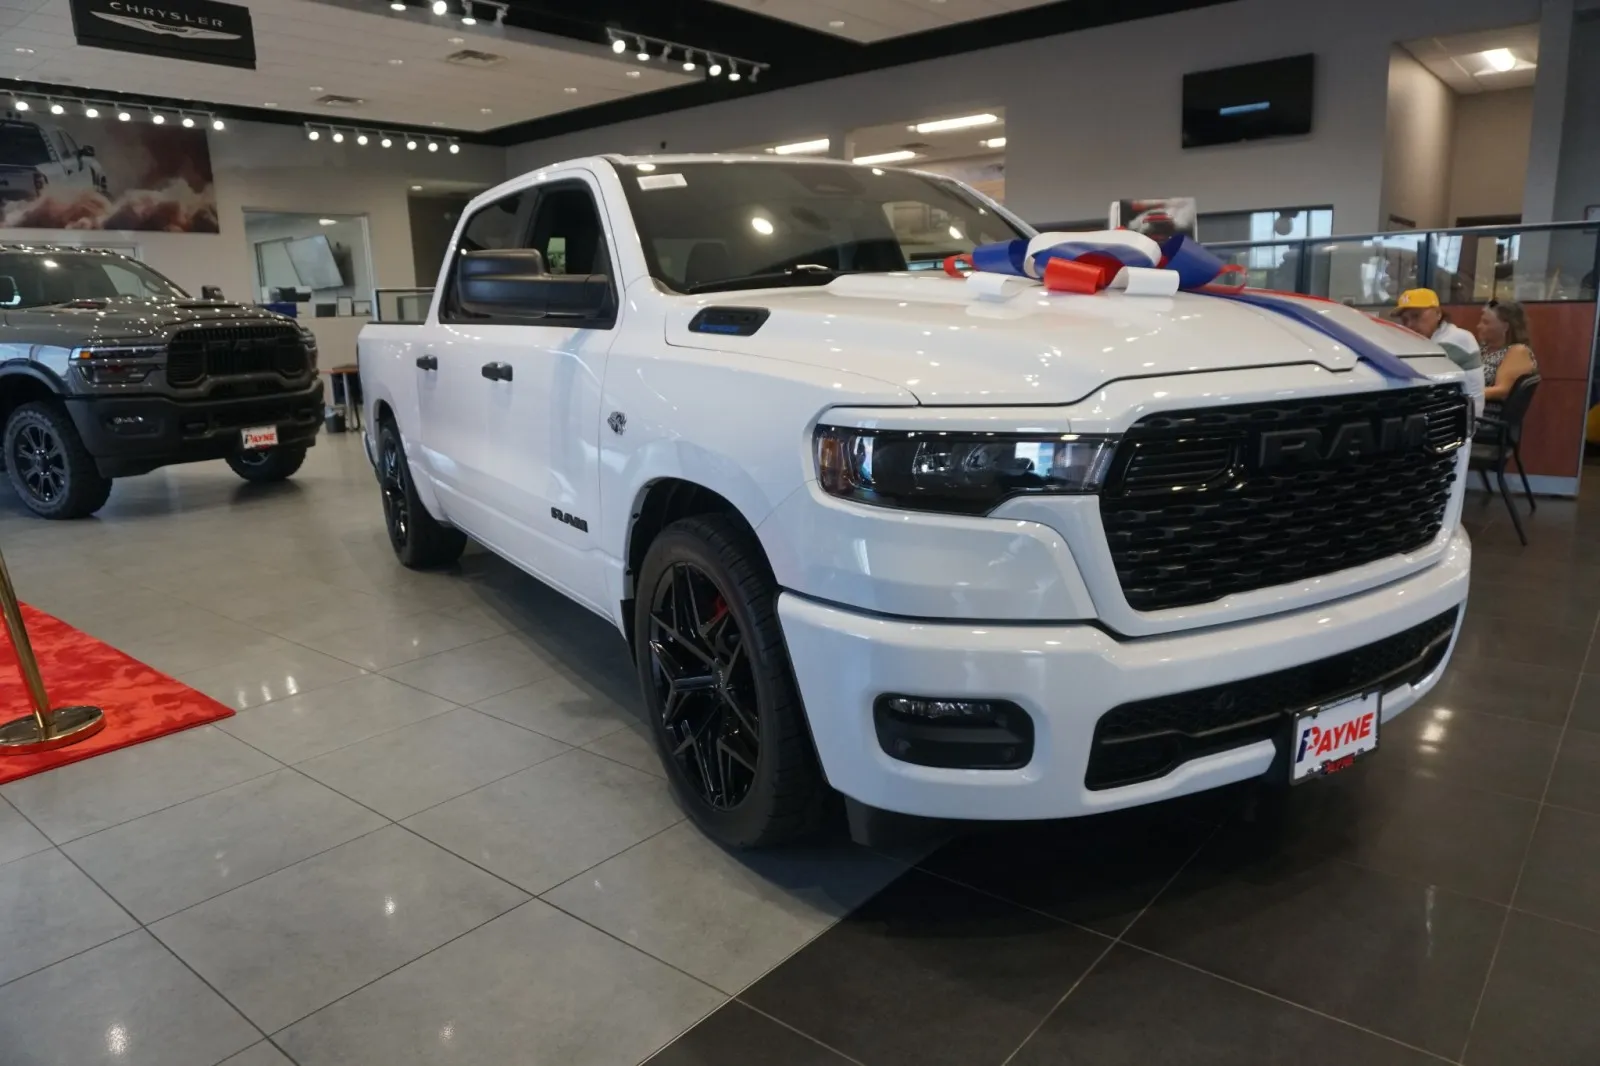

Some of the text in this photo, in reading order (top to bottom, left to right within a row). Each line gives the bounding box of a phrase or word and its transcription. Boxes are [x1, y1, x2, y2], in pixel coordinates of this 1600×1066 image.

[110, 2, 225, 28] CHRYSLER
[244, 432, 275, 445] PAYNE
[1258, 413, 1427, 468] RAM
[550, 506, 589, 534] RAM
[1296, 712, 1374, 764] PAYNE
